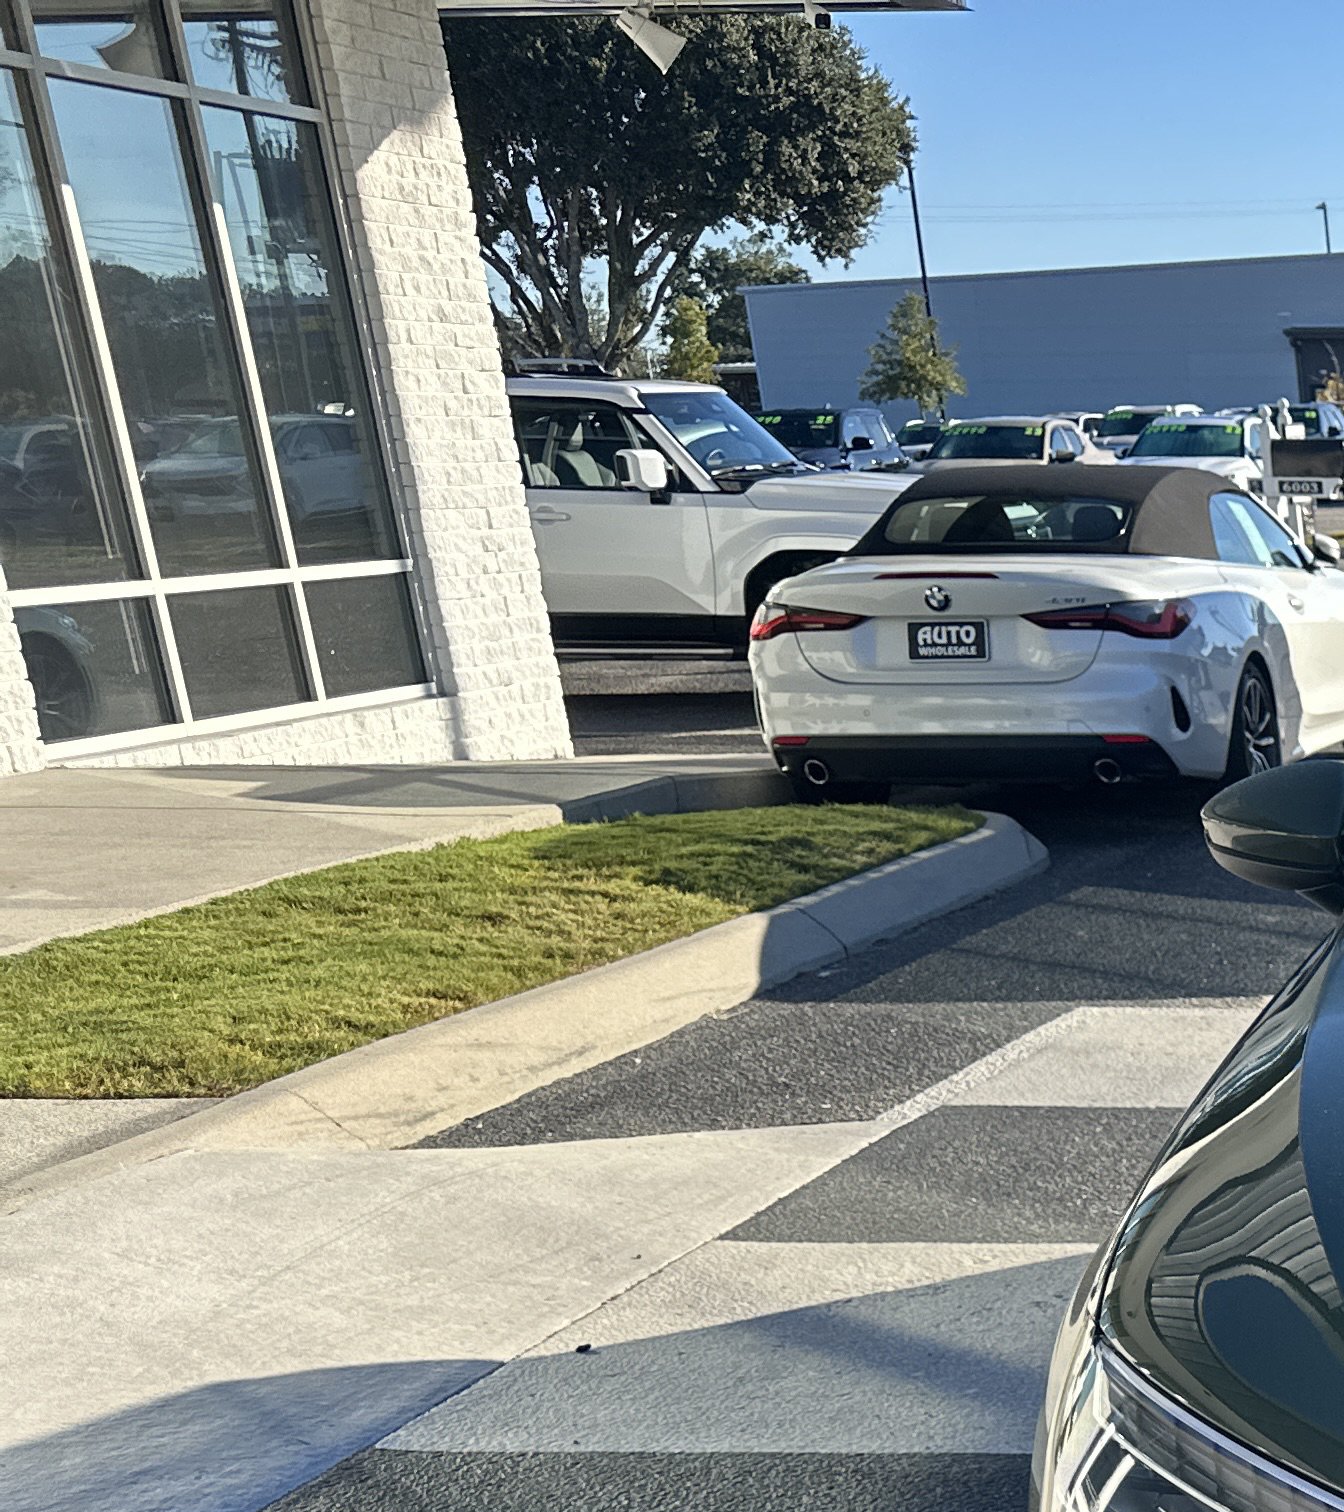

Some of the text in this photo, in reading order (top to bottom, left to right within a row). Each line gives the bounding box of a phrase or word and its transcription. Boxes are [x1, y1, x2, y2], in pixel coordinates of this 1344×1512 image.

[1282, 482, 1319, 493] 6003
[917, 625, 977, 646] AUTO
[918, 645, 978, 657] WHOLESALE
